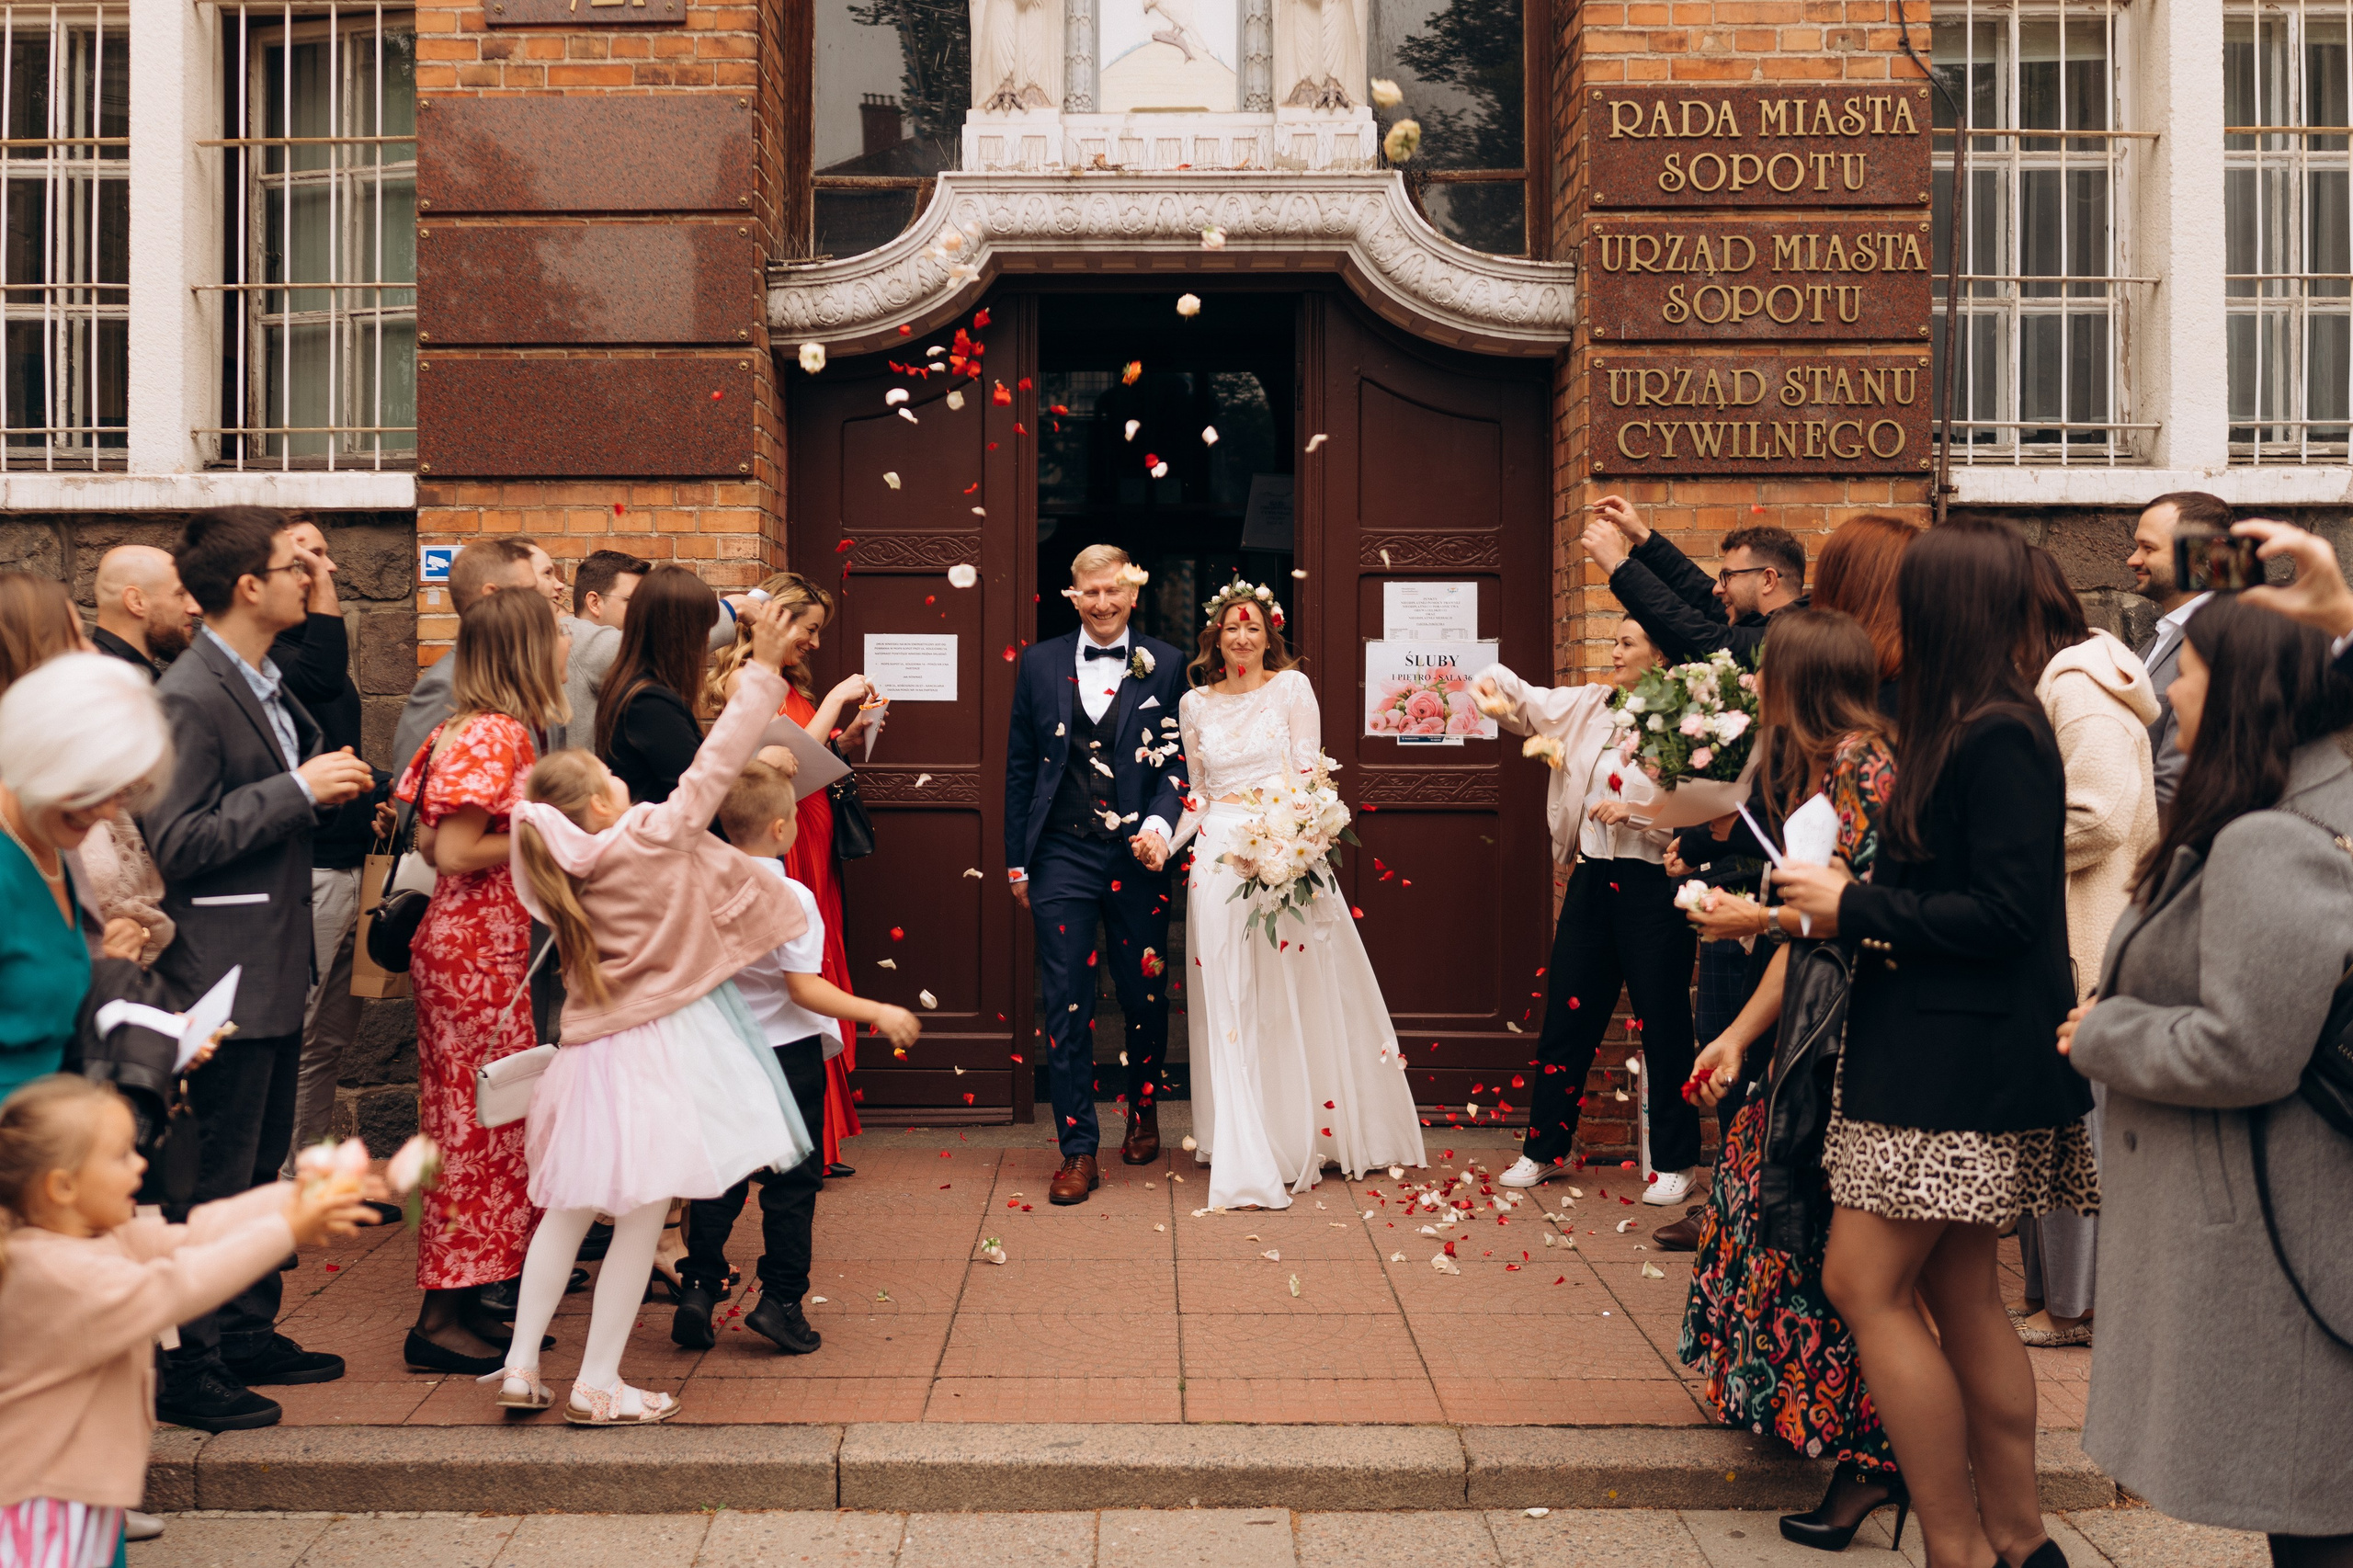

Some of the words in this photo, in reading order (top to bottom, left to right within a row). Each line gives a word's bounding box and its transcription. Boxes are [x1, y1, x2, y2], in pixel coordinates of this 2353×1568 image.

[1608, 99, 1743, 139] RADA
[1758, 95, 1919, 137] MIASTA
[1658, 151, 1867, 192] SOPOTU
[1598, 232, 1756, 277] URZĄD
[1771, 232, 1927, 272] MIASTA
[1662, 282, 1862, 324] SOPOTU
[1607, 366, 1767, 411] URZĄD
[1779, 365, 1918, 406] STANU
[1617, 418, 1905, 460] CYWILNEGO
[1397, 674, 1431, 682] PIĘTRO
[1438, 674, 1462, 682] SALA
[1462, 674, 1472, 682] 36
[1404, 651, 1460, 667] ŚLUBY
